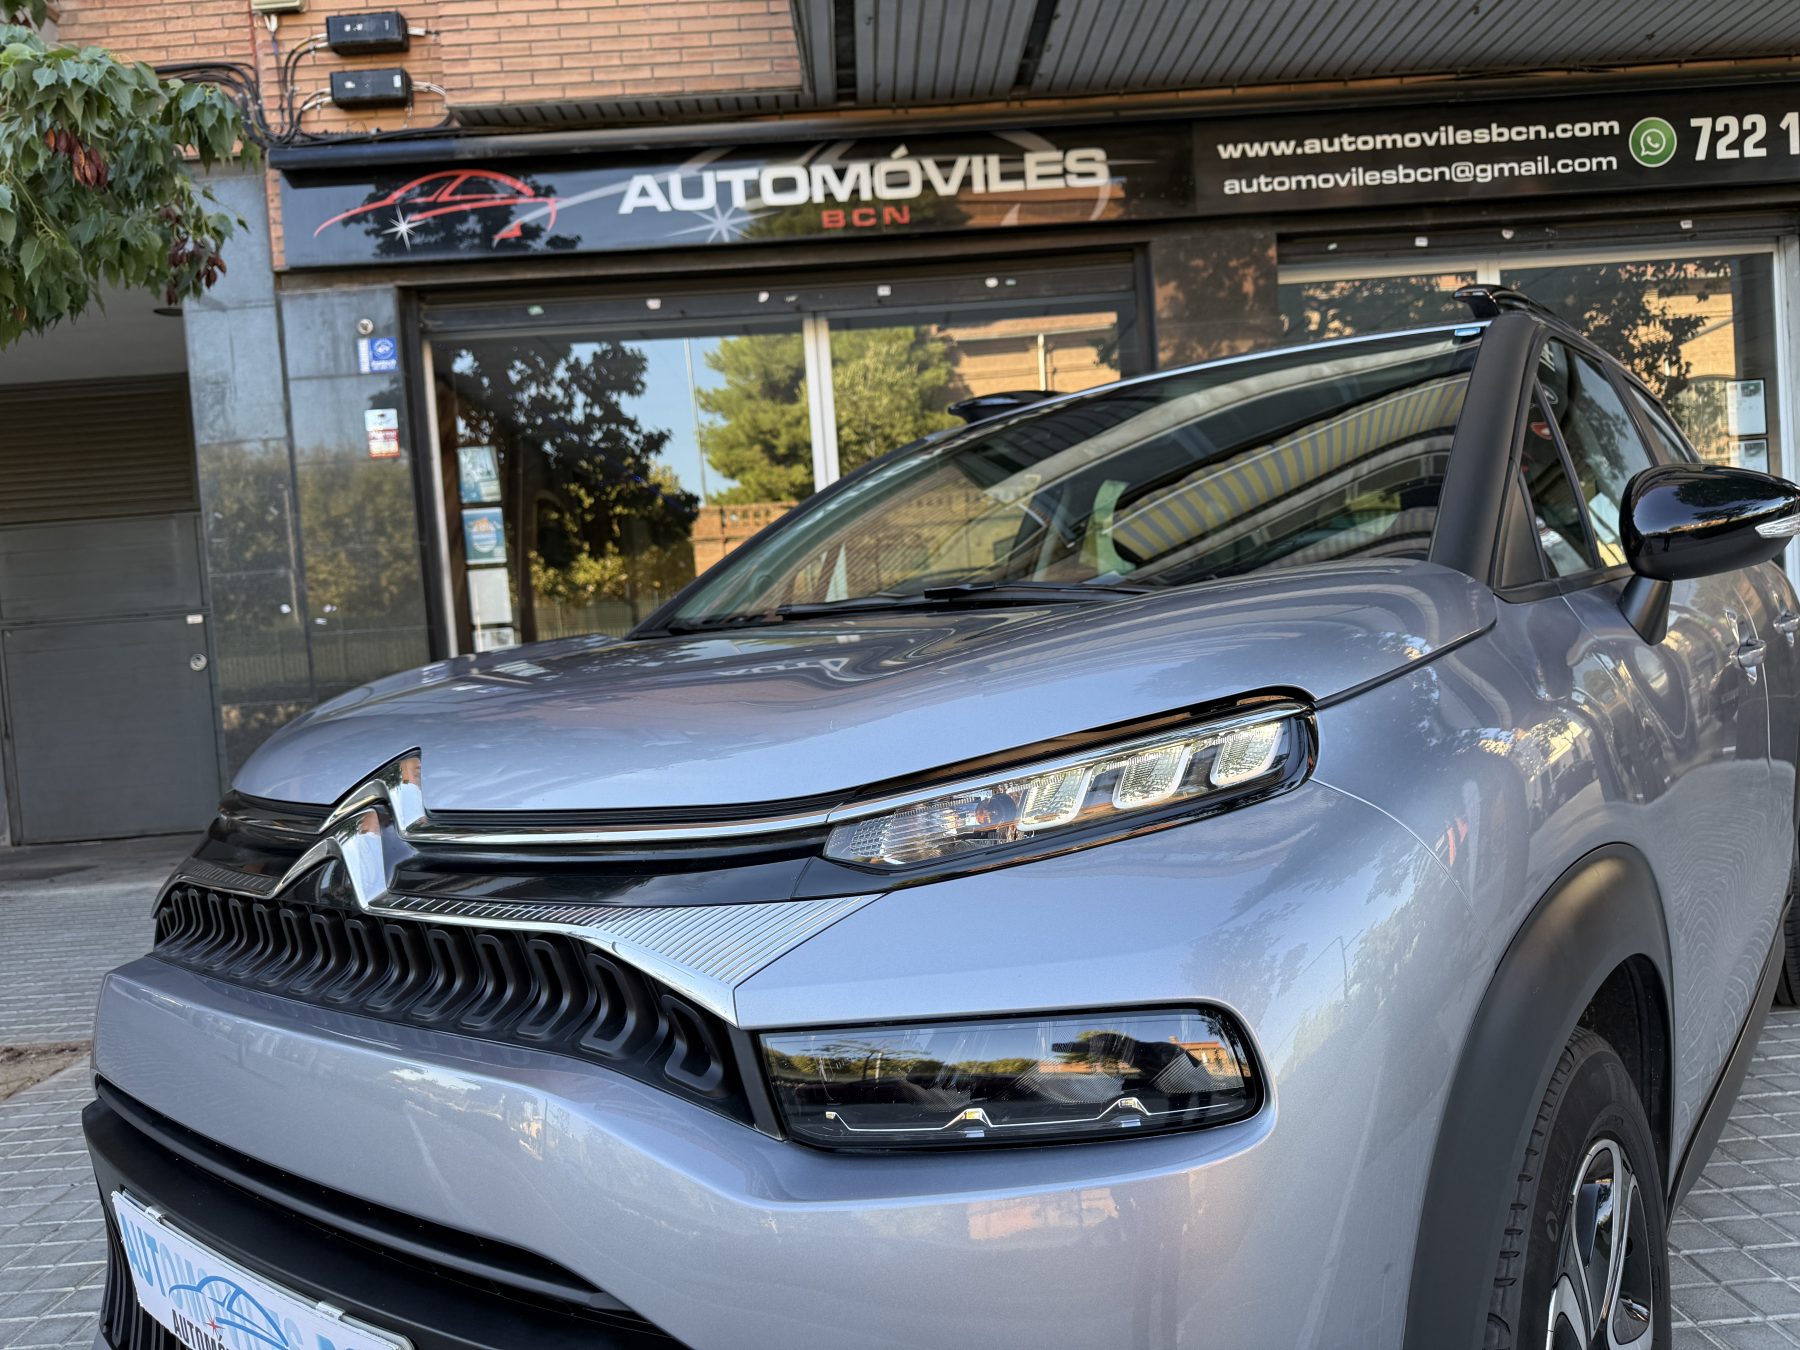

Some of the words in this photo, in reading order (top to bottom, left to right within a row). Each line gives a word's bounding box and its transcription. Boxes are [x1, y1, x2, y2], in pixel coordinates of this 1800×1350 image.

[1217, 119, 1620, 160] www.automovilesbcn.com
[1690, 113, 1767, 161] 722
[618, 144, 1109, 214] AUTOMÓVILES
[1223, 155, 1618, 195] automovilesbcn@gmail.com
[821, 205, 910, 229] BCN
